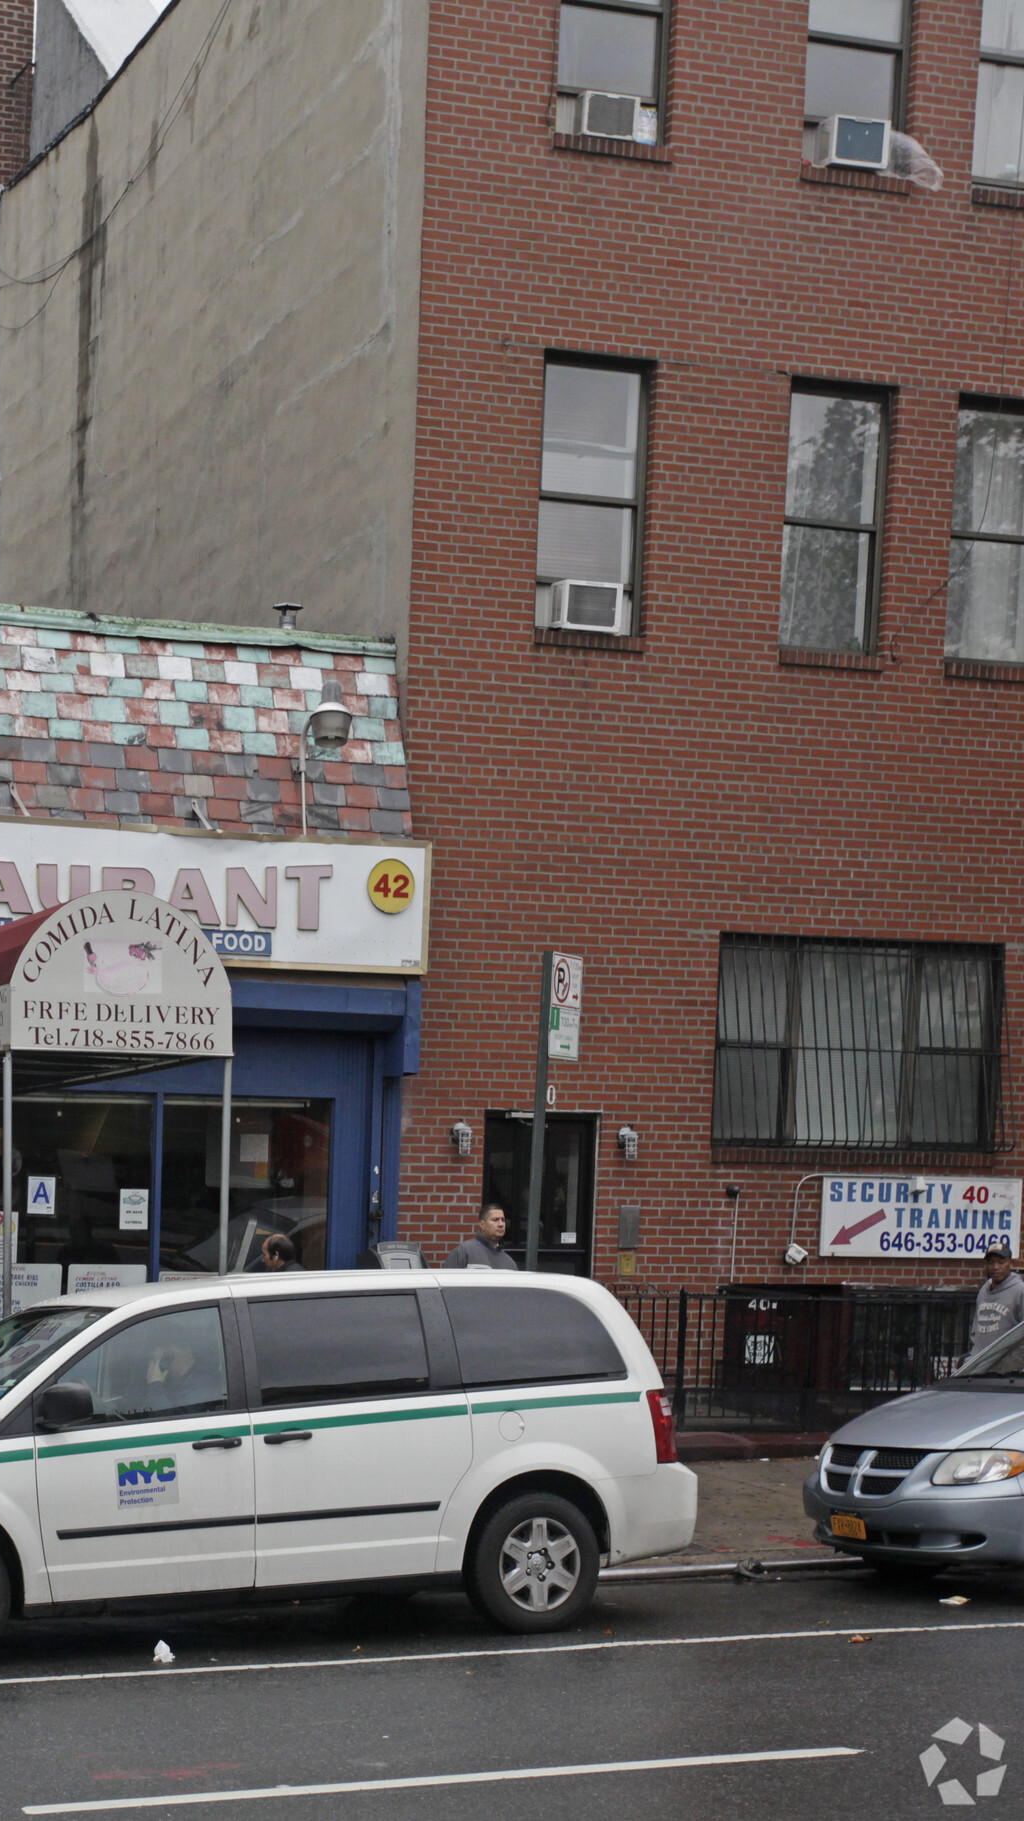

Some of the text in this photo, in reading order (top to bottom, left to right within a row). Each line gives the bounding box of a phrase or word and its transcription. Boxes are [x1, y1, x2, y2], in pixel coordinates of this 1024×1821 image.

[373, 873, 410, 899] 42
[22, 897, 215, 988] COMIDA LATINA
[211, 932, 267, 952] FOOD
[96, 1003, 221, 1026] DELIVERY
[32, 1181, 50, 1204] A
[962, 1185, 989, 1204] 40
[894, 1207, 1012, 1231] TRAINING
[117, 1457, 176, 1487] NYC
[119, 1486, 166, 1497] Environmental
[119, 1497, 154, 1506] Protection
